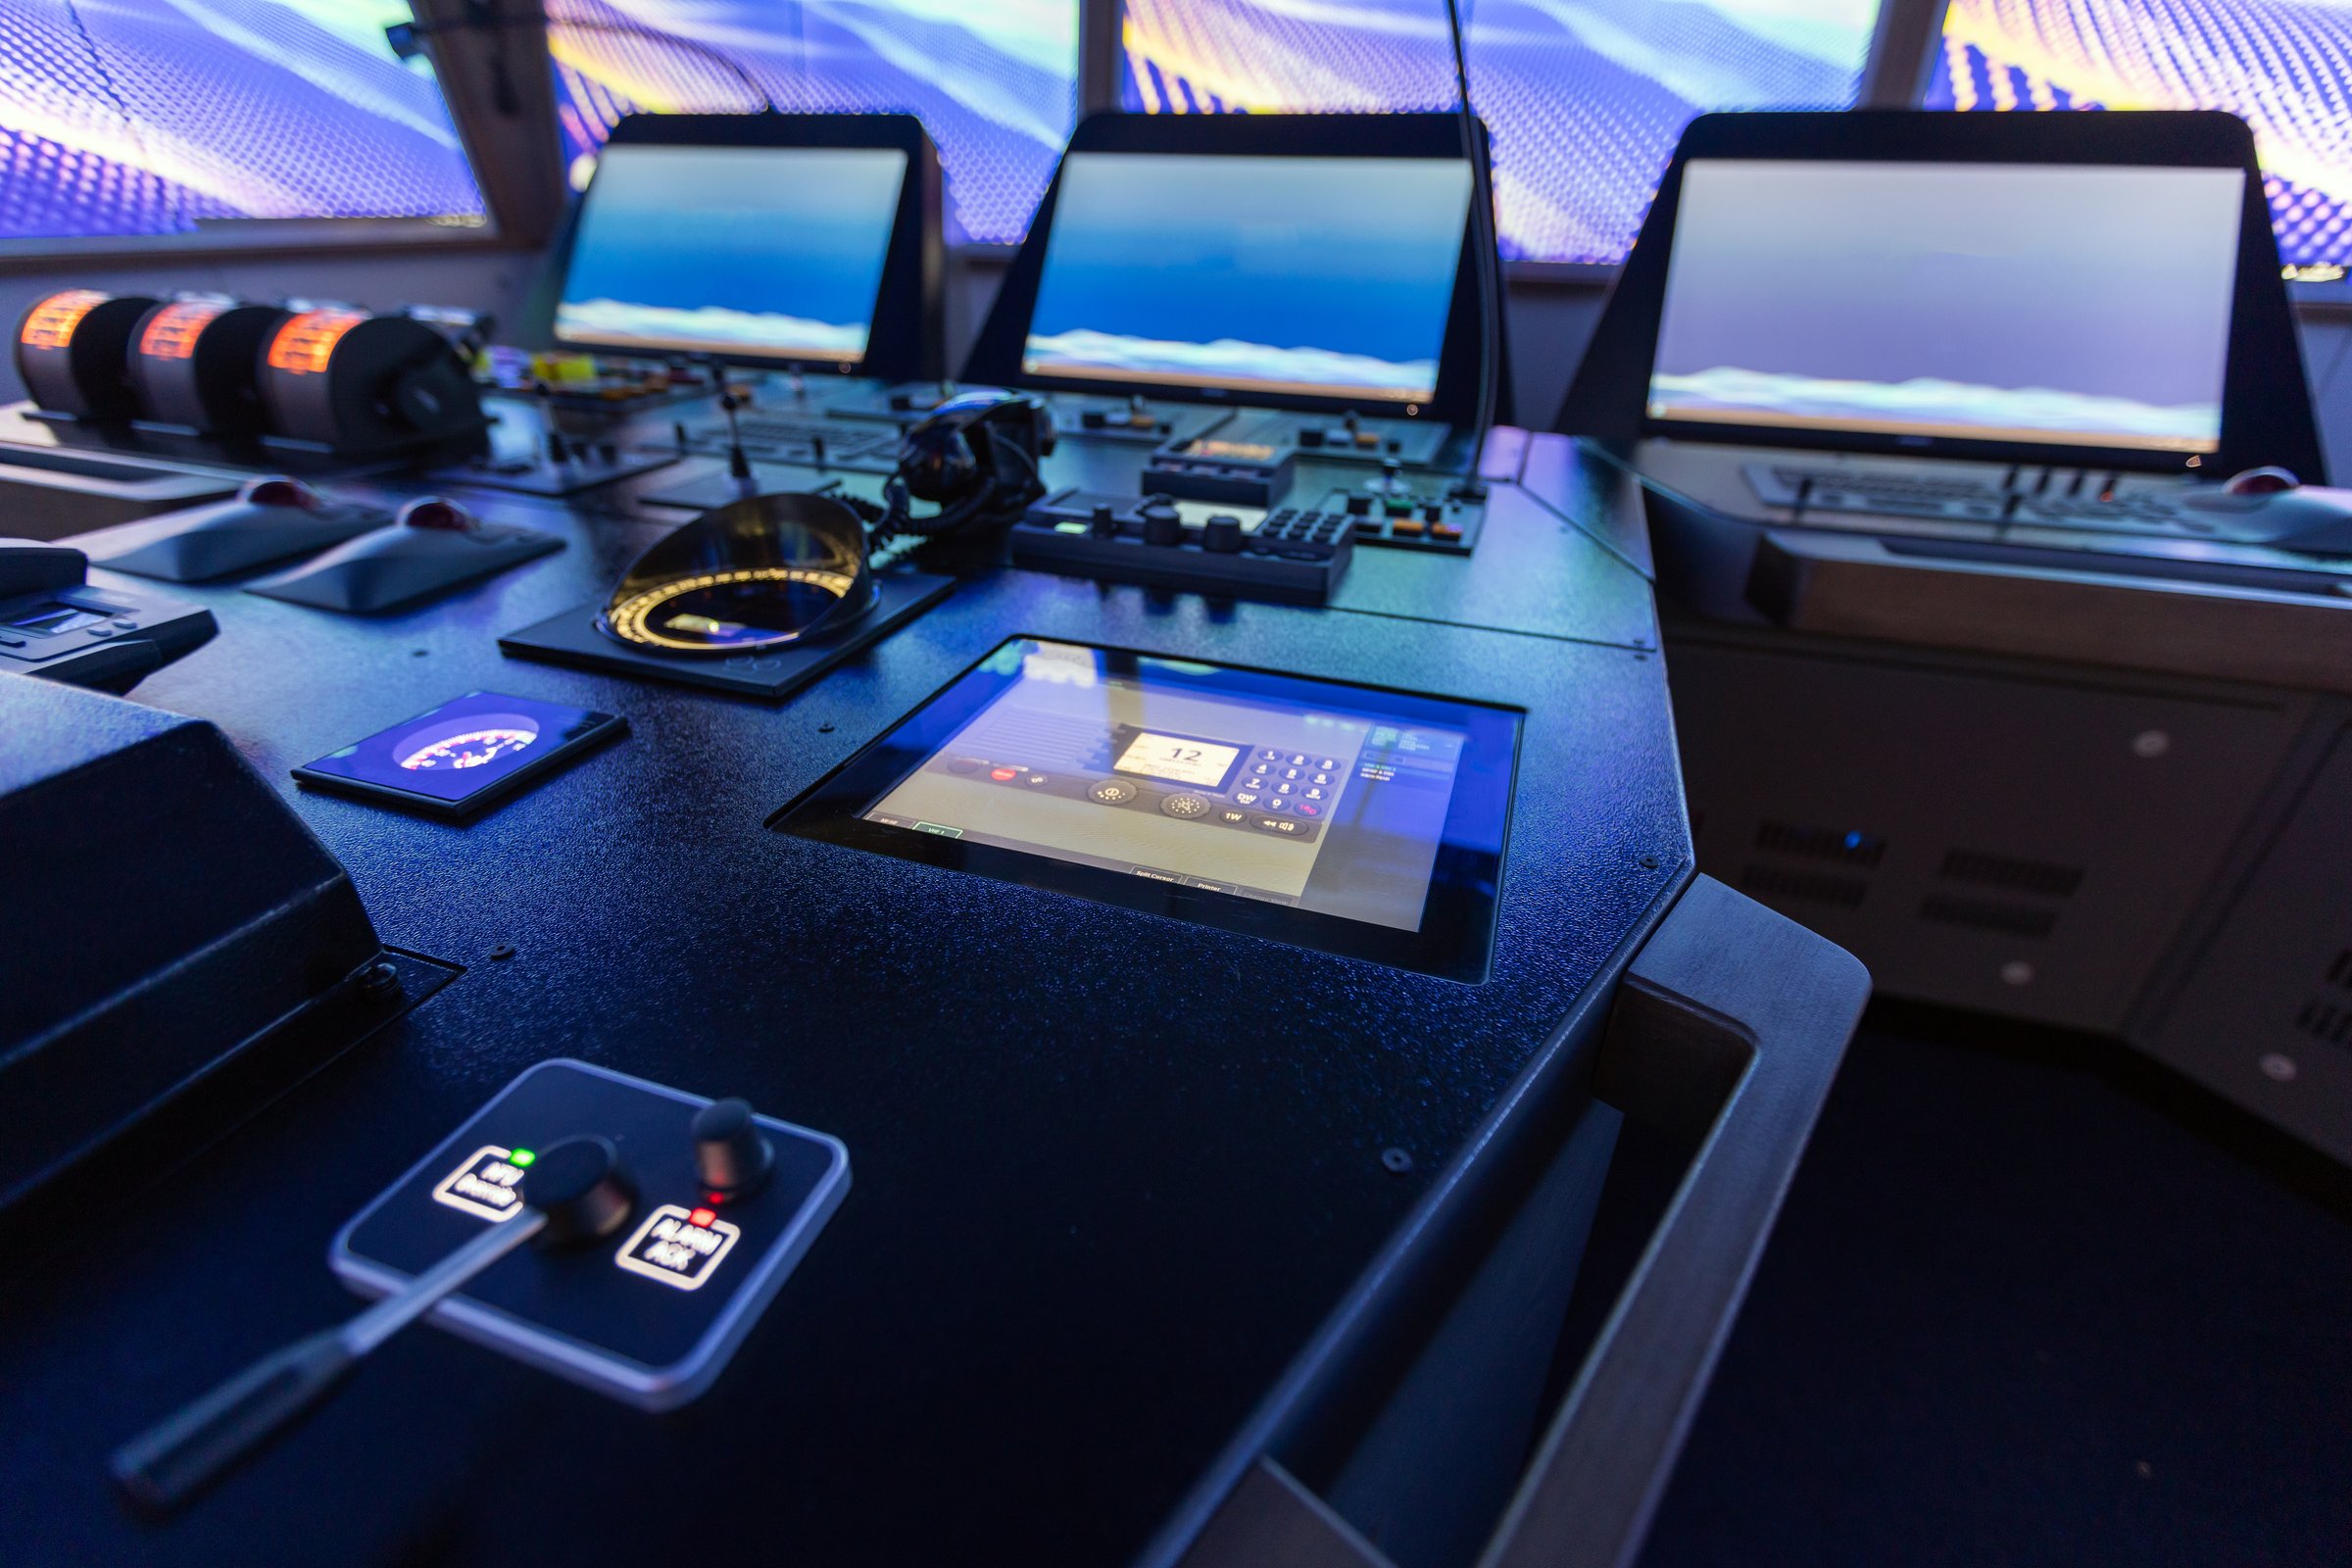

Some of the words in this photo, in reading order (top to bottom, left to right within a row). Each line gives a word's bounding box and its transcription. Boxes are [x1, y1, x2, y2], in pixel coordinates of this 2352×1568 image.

[1171, 748, 1202, 762] 12
[1151, 873, 1174, 882] Cursor
[1198, 883, 1221, 892] Printer
